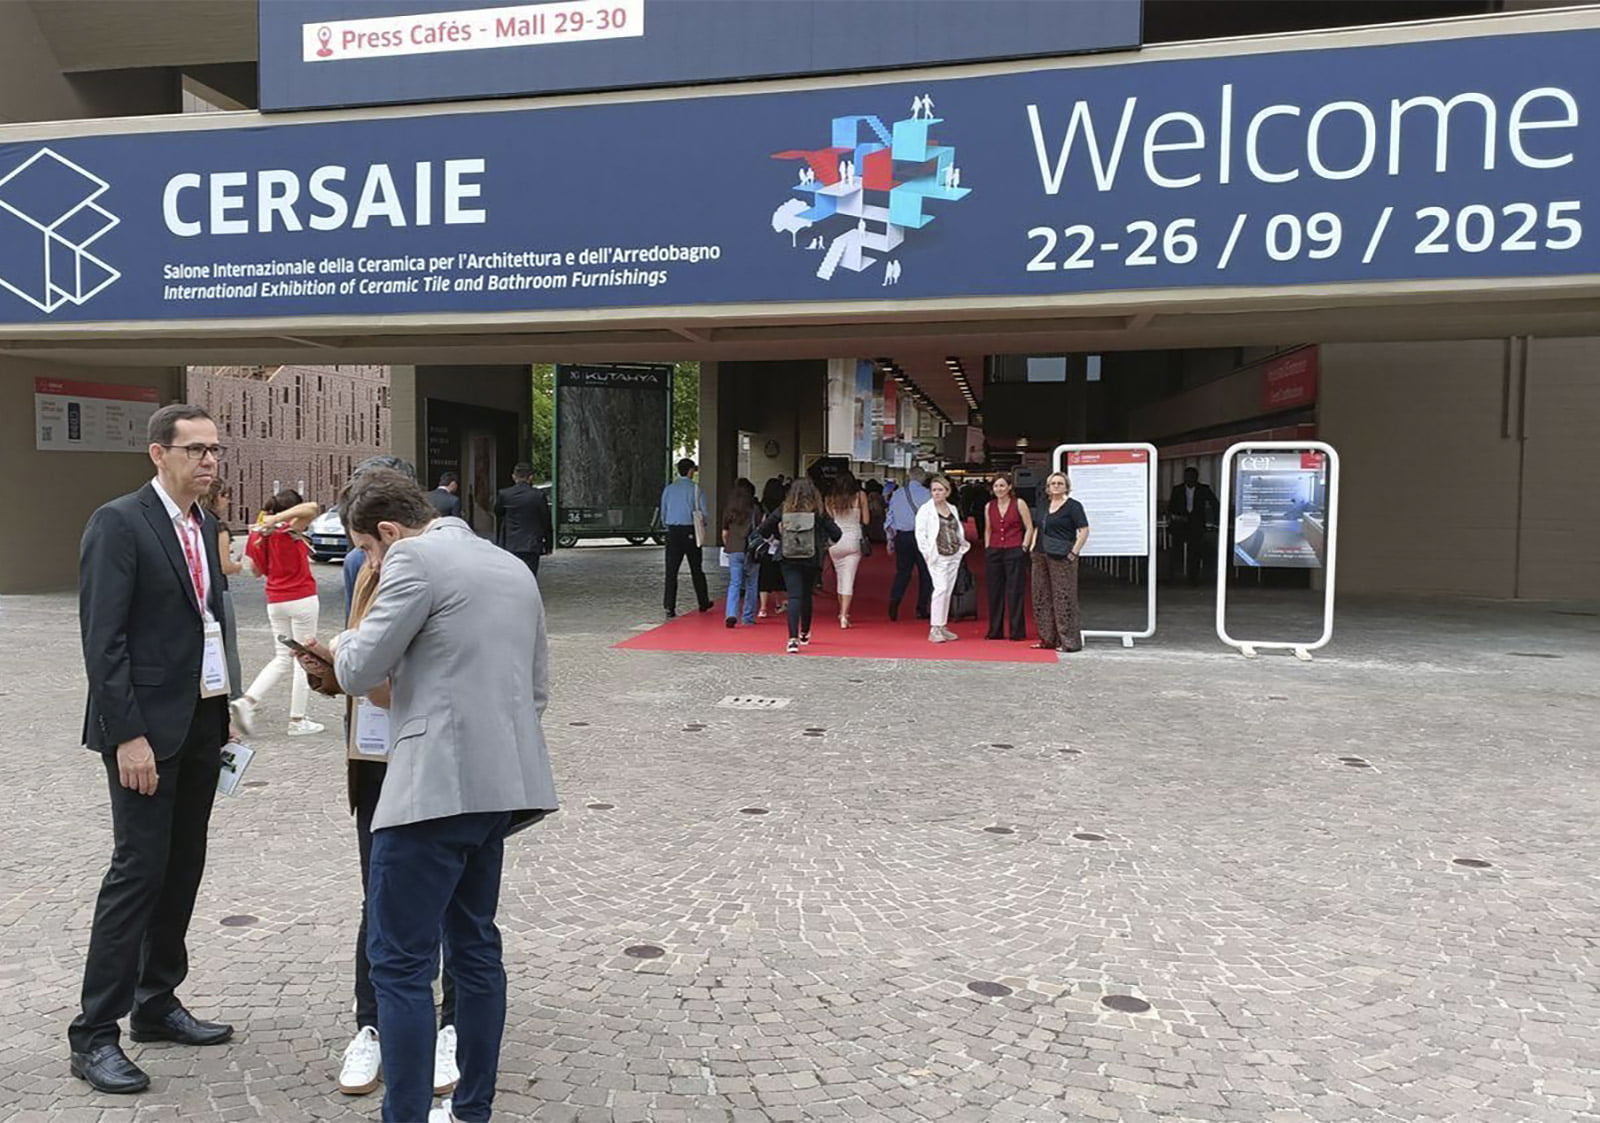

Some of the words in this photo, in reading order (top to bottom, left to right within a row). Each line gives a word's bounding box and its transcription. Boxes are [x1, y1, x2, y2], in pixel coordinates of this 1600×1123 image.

[341, 30, 403, 50] Press
[410, 20, 472, 45] Cafés
[495, 13, 545, 38] Mall
[554, 7, 627, 34] 29-30
[1026, 83, 1580, 195] Welcome
[162, 158, 486, 237] CERSAIE
[163, 263, 210, 279] Salone
[213, 258, 316, 278] Internazionale
[318, 257, 355, 274] della
[358, 255, 426, 273] Ceramica
[429, 256, 456, 274] per
[458, 251, 562, 270] l'Architettura
[565, 253, 576, 266] e
[578, 244, 721, 266] dell'Arredobagno
[1026, 217, 1198, 272] 22-26
[1217, 213, 1248, 270] /
[1265, 211, 1343, 261] 09
[1362, 206, 1394, 264] /
[1414, 200, 1583, 254] 2025
[163, 280, 258, 300] International
[260, 278, 337, 298] Exhibition
[340, 277, 357, 295] of
[359, 276, 420, 295] Ceramic
[424, 275, 451, 292] Tile
[454, 275, 485, 292] and
[487, 271, 568, 291] Bathroom
[571, 268, 668, 289] Furnishings
